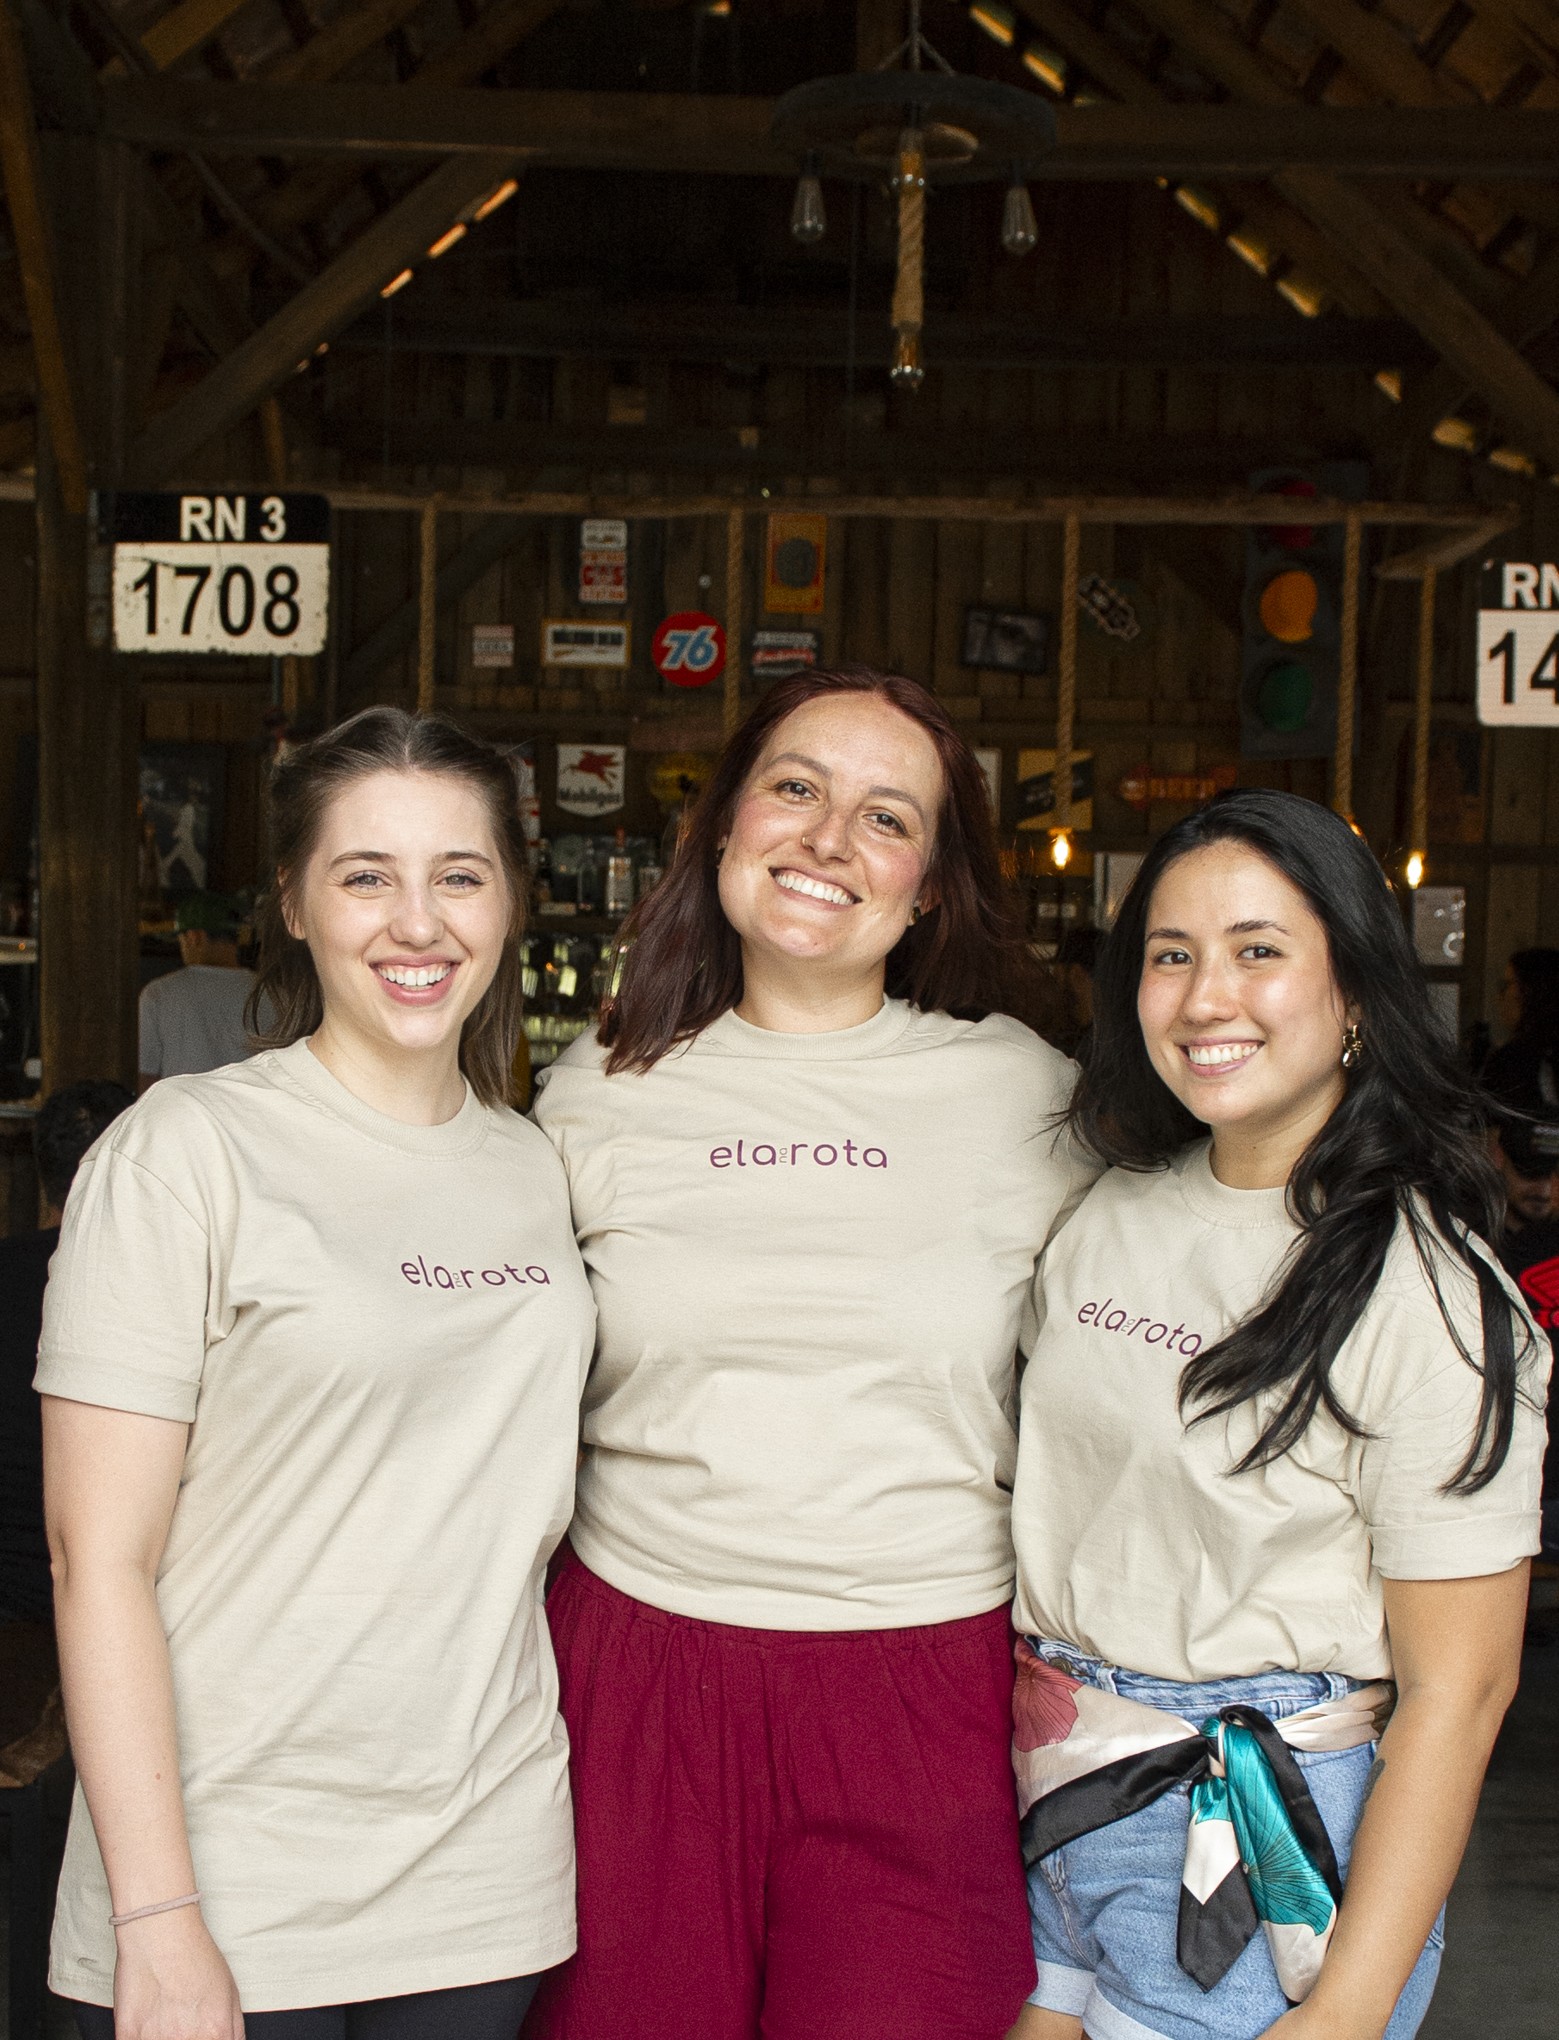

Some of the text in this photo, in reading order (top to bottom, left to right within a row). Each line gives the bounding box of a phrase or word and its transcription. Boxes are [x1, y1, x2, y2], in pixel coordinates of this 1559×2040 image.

[180, 496, 287, 541] RN 3
[134, 562, 300, 637] 1708
[661, 626, 720, 671] 76
